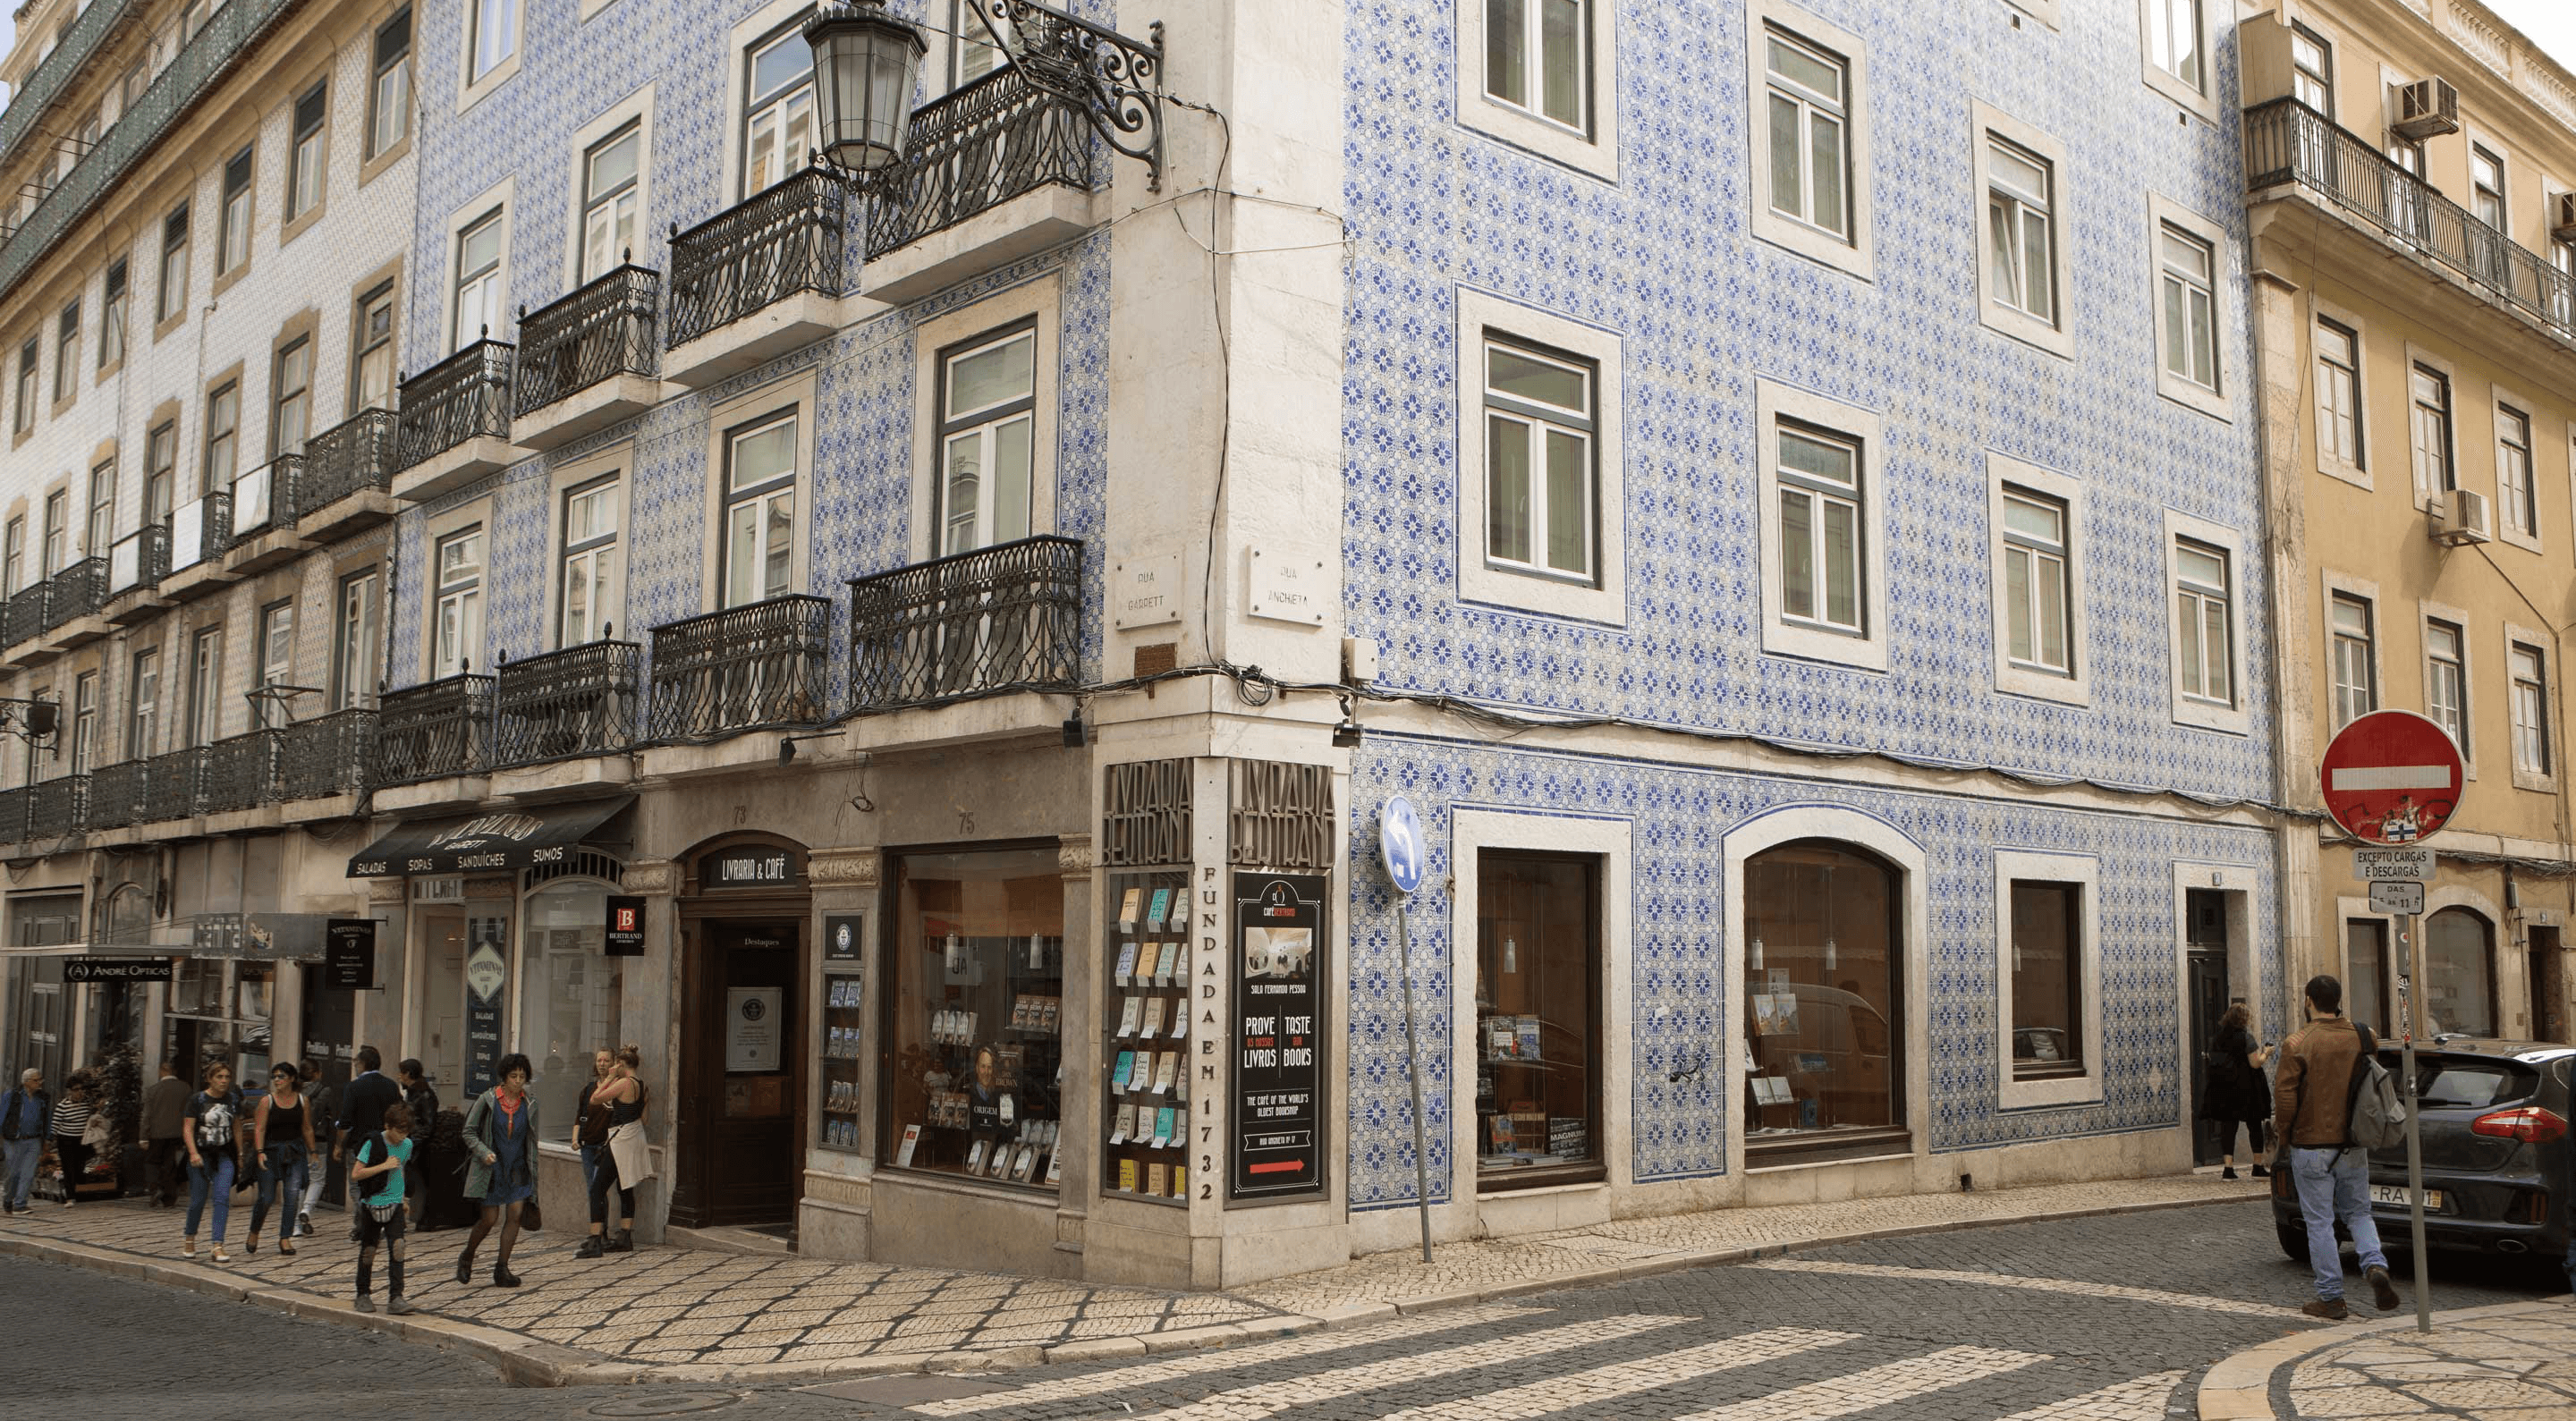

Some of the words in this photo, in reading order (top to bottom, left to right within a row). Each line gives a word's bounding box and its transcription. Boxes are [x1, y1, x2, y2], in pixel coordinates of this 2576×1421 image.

[1138, 571, 1155, 583] RUA
[1281, 566, 1296, 579] RUA
[1128, 596, 1164, 610] GARRETT
[1267, 590, 1309, 605] ANCHIETA
[1102, 758, 1194, 815] LIVRARIA
[1229, 760, 1335, 816] LIVRARIA
[734, 806, 746, 825] 73
[959, 812, 975, 834] 75
[1102, 809, 1193, 865] BERTRAND
[1230, 810, 1336, 867] BERTRAND
[356, 861, 386, 875] SALADAS
[408, 858, 433, 871] SOPAS
[457, 850, 505, 868] SANDUÍCHES
[532, 846, 564, 862] SUMOS
[2358, 851, 2393, 863] EXCEPTO
[2394, 850, 2427, 862] CARGAS
[722, 859, 755, 881] LIVRARIA
[757, 862, 763, 879] &
[766, 852, 785, 879] CAFÉ
[2365, 866, 2370, 877] E
[2372, 866, 2419, 877] DESCARGAS
[2400, 898, 2410, 908] 11
[622, 910, 633, 926] B
[744, 937, 780, 948] Destaques
[1202, 867, 1216, 1023] FUNDADA
[93, 966, 127, 977] ANDRÉ
[129, 965, 170, 977] OPTICAS
[1250, 985, 1263, 994] SALA
[1264, 985, 1288, 994] FERNANDO
[1289, 984, 1307, 994] PESSOA
[1245, 1017, 1275, 1036] PROVE
[1284, 1016, 1311, 1035] TASTE
[1255, 1037, 1275, 1046] NOSSOS
[1201, 1041, 1215, 1079] EM
[1244, 1049, 1276, 1068] LIVROS
[1284, 1048, 1311, 1067] BOOKS
[1247, 1096, 1256, 1106] THE
[1257, 1094, 1269, 1105] CAFÉ
[1270, 1095, 1276, 1104] OF
[1278, 1095, 1287, 1104] THE
[1288, 1093, 1309, 1104] WORLD'S
[973, 1105, 997, 1115] ORIGEM
[1258, 1106, 1274, 1117] OLDEST
[1550, 1129, 1587, 1142] MAGNUM
[1200, 1098, 1213, 1200] 1732
